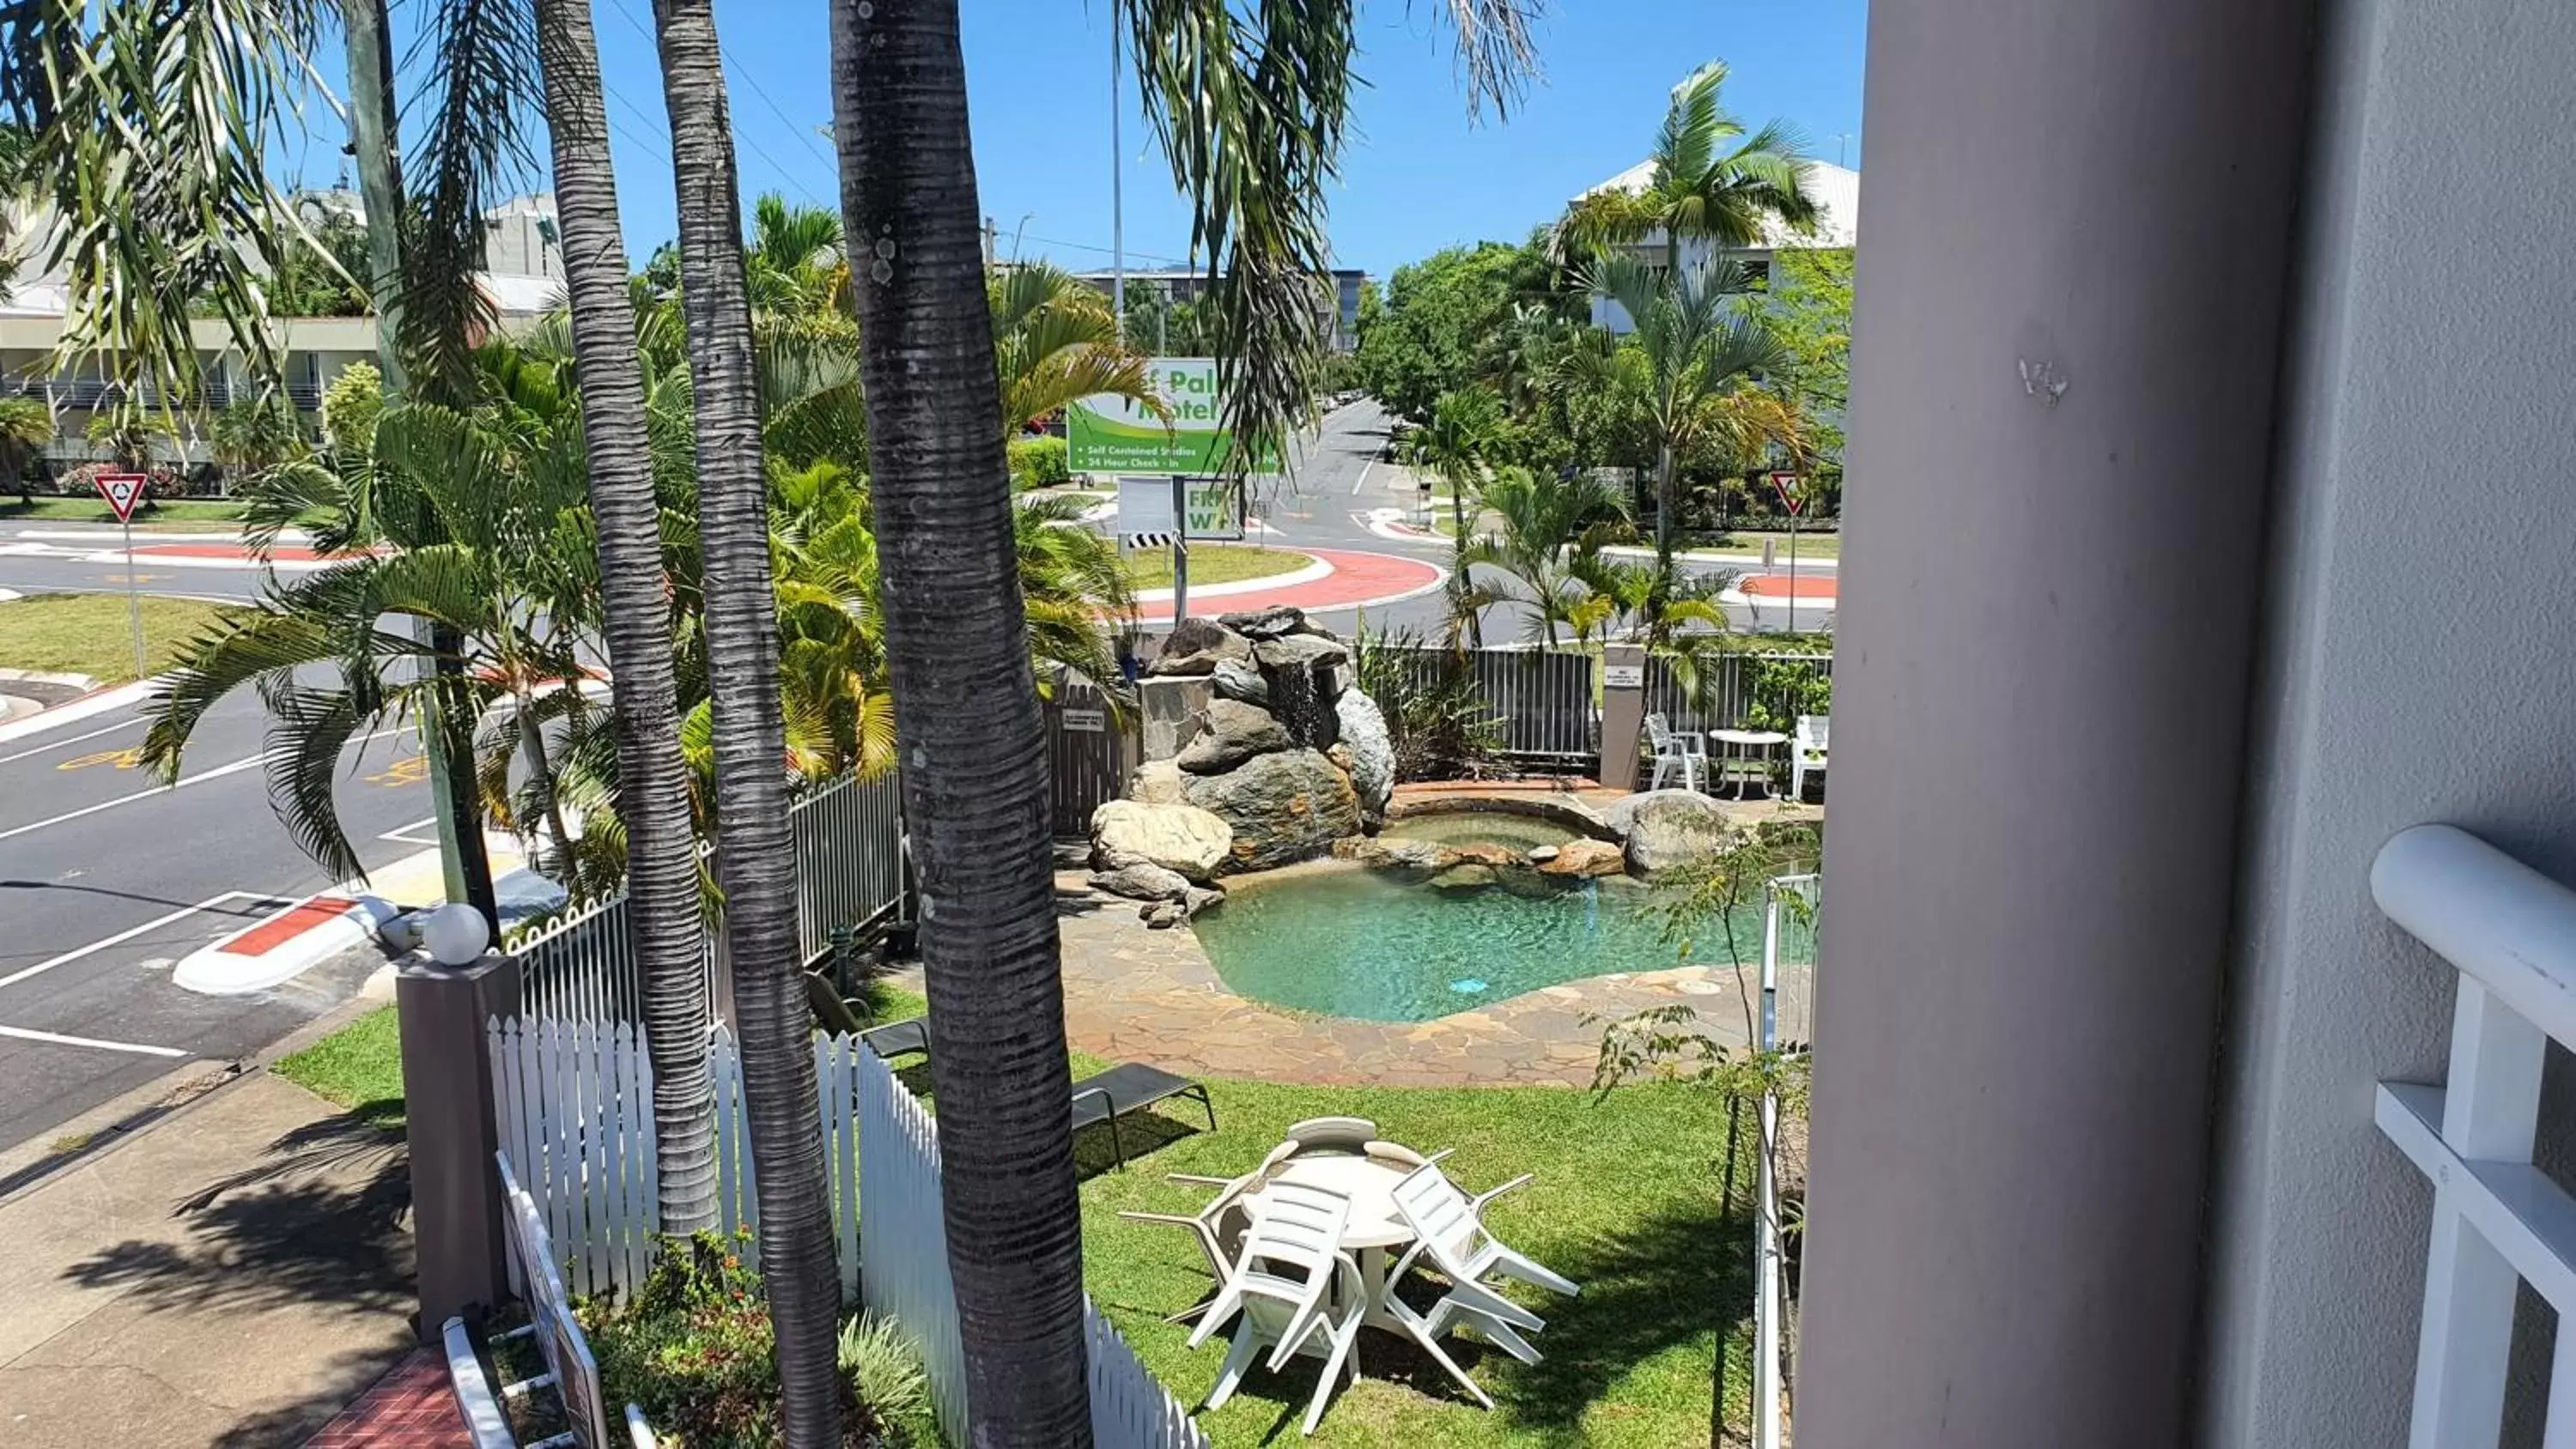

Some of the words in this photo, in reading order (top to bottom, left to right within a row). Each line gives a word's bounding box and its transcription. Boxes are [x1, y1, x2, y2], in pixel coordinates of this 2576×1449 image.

[1170, 368, 1213, 394] Pal
[1087, 446, 1106, 455] Self
[1109, 446, 1158, 456] Contained
[1088, 457, 1101, 467] 24
[1103, 457, 1127, 468] Hour
[1130, 457, 1160, 468] Check
